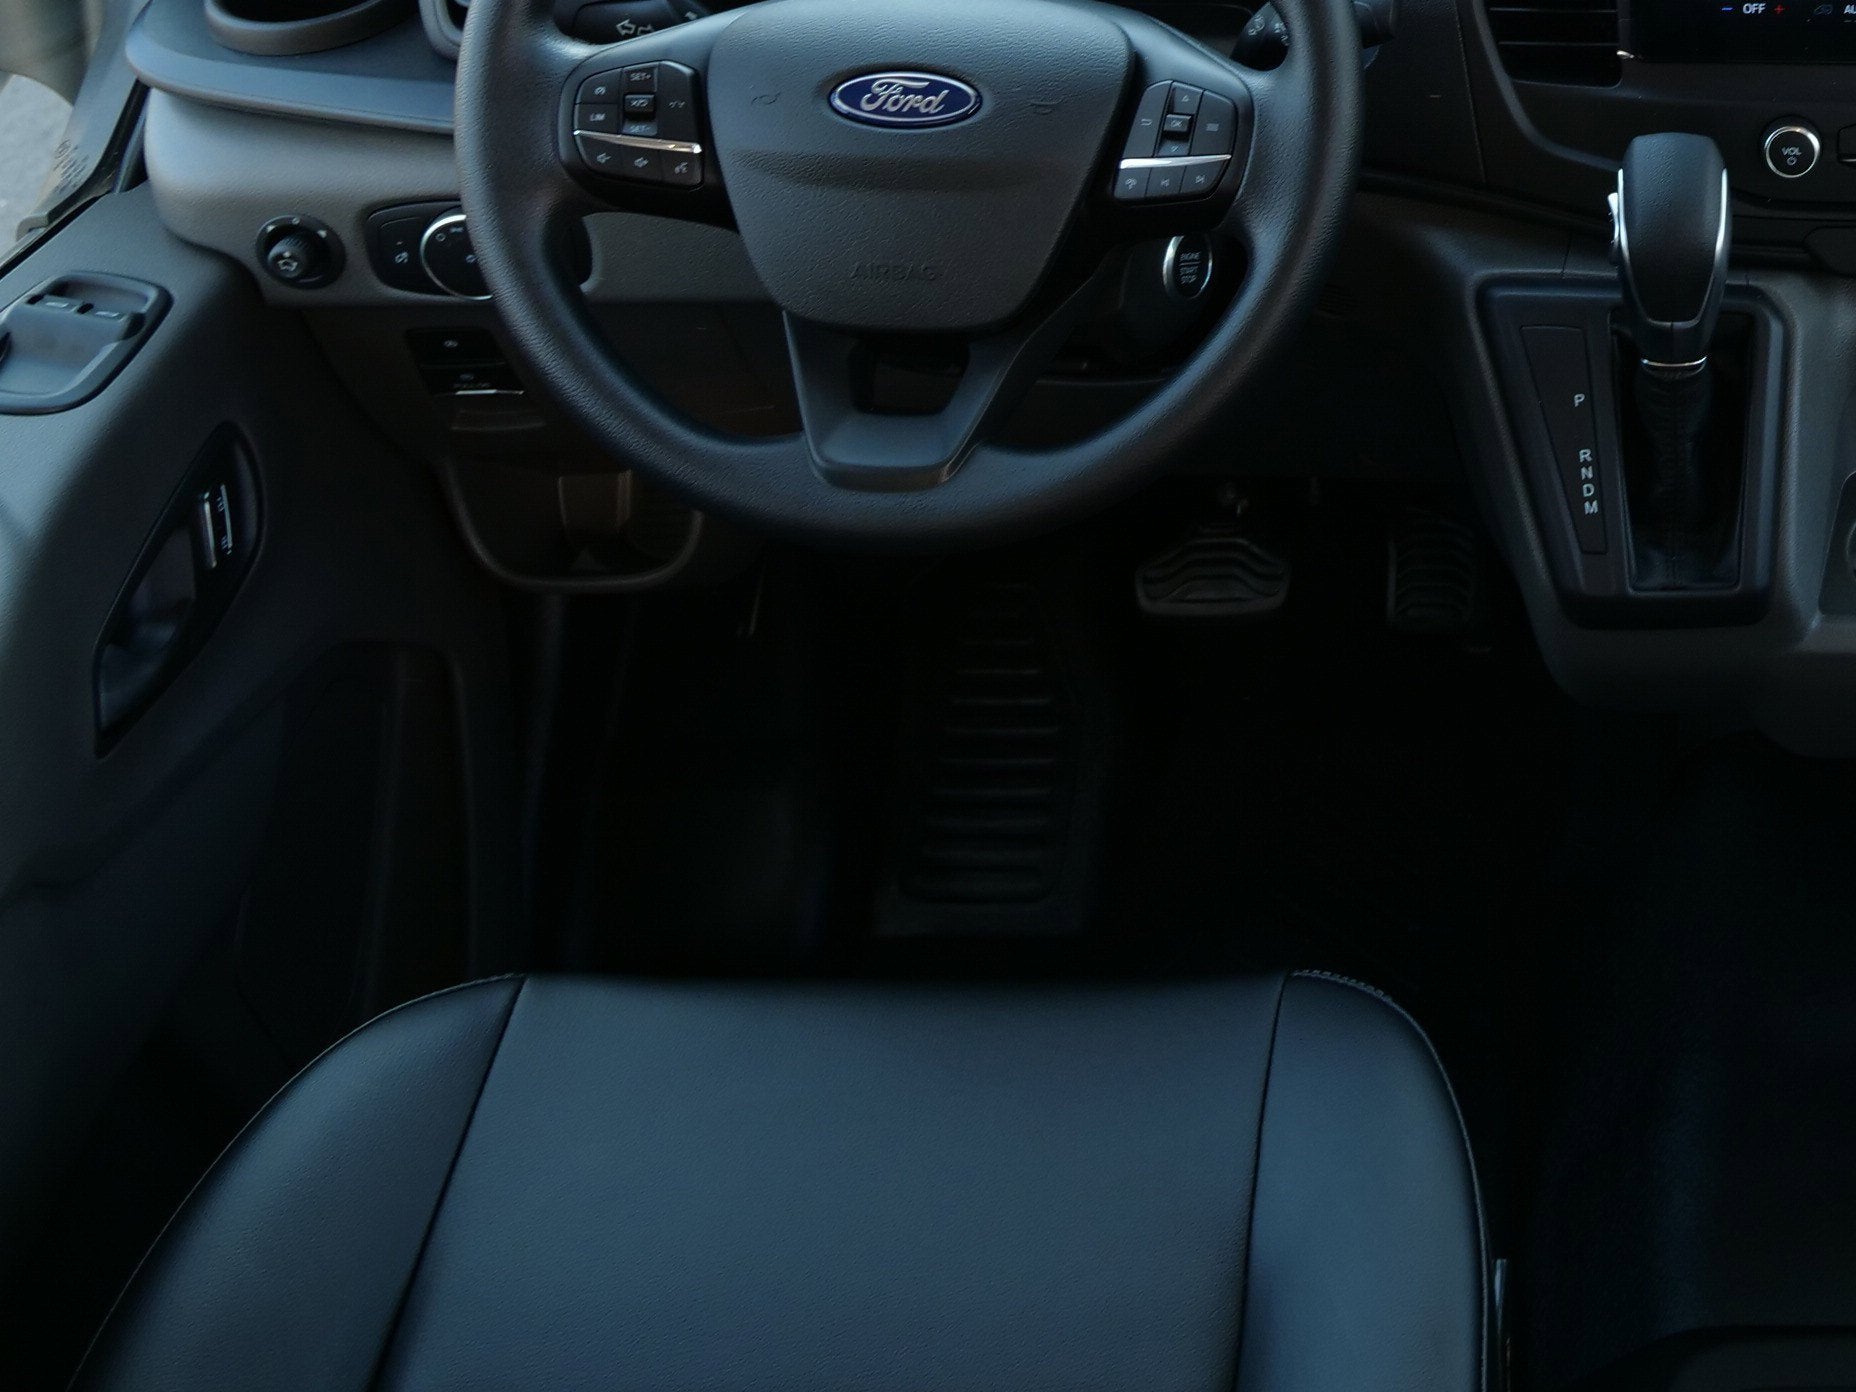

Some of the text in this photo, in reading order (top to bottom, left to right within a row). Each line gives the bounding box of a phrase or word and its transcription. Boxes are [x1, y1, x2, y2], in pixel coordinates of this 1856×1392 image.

[1743, 3, 1767, 15] OFF
[858, 77, 949, 116] Ford
[1573, 394, 1585, 408] P
[1579, 449, 1593, 463] R
[1580, 466, 1593, 480] N
[1583, 483, 1595, 498] D
[1584, 500, 1598, 515] M
